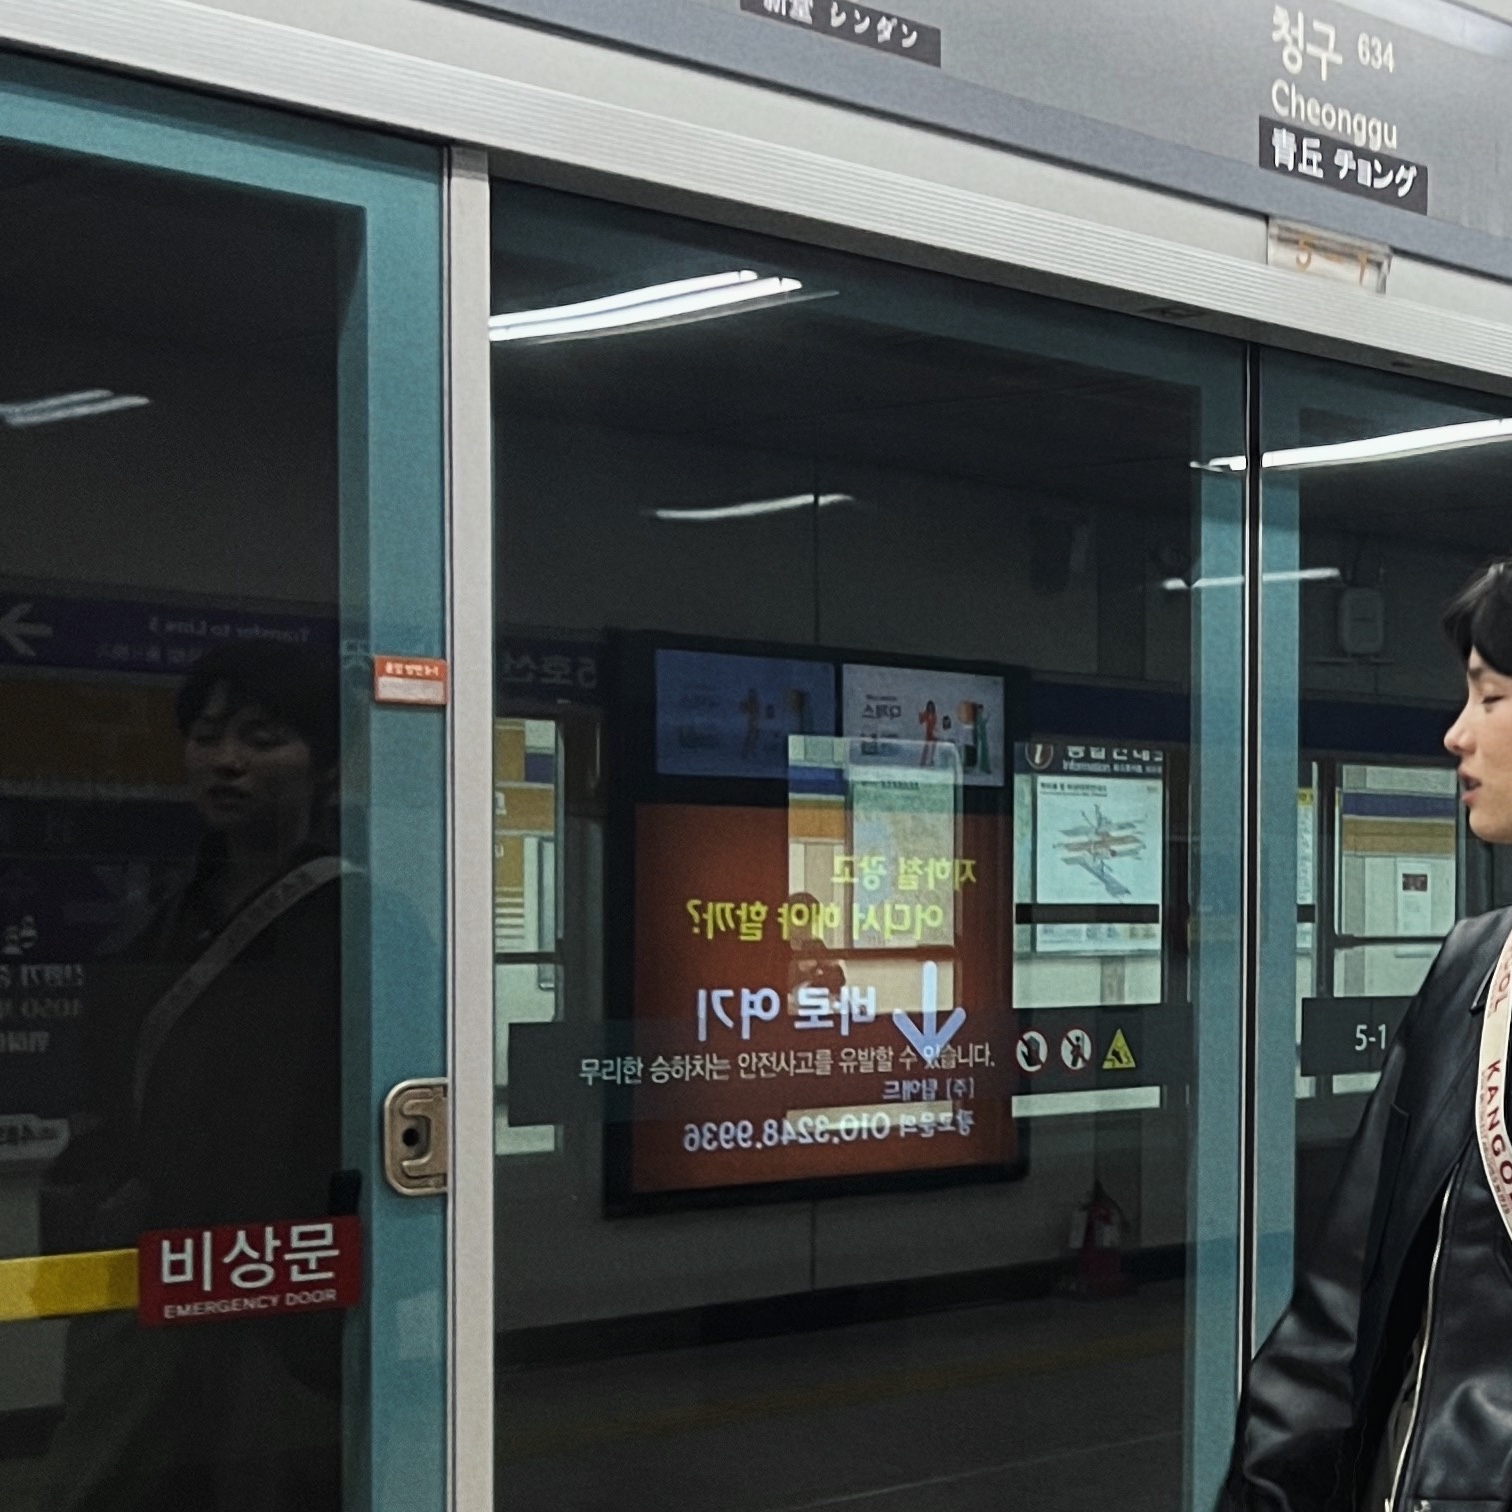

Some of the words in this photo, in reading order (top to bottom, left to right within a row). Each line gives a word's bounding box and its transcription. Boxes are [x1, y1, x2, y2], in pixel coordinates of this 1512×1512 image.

[1272, 4, 1343, 82] 청구
[1357, 32, 1395, 73] 634
[1271, 78, 1398, 152] Cheonggu
[579, 1055, 644, 1086] 무리한
[650, 1052, 731, 1084] 승하차는
[737, 1048, 834, 1080] 안전사고를
[838, 1045, 894, 1074] 유발할
[898, 1046, 918, 1071] 수
[923, 1041, 995, 1070] 있습니다.
[1355, 1023, 1387, 1052] 5-1
[161, 1223, 340, 1292] 비상문
[164, 1294, 281, 1319] EMERGENCY
[285, 1288, 337, 1306] DOOR
